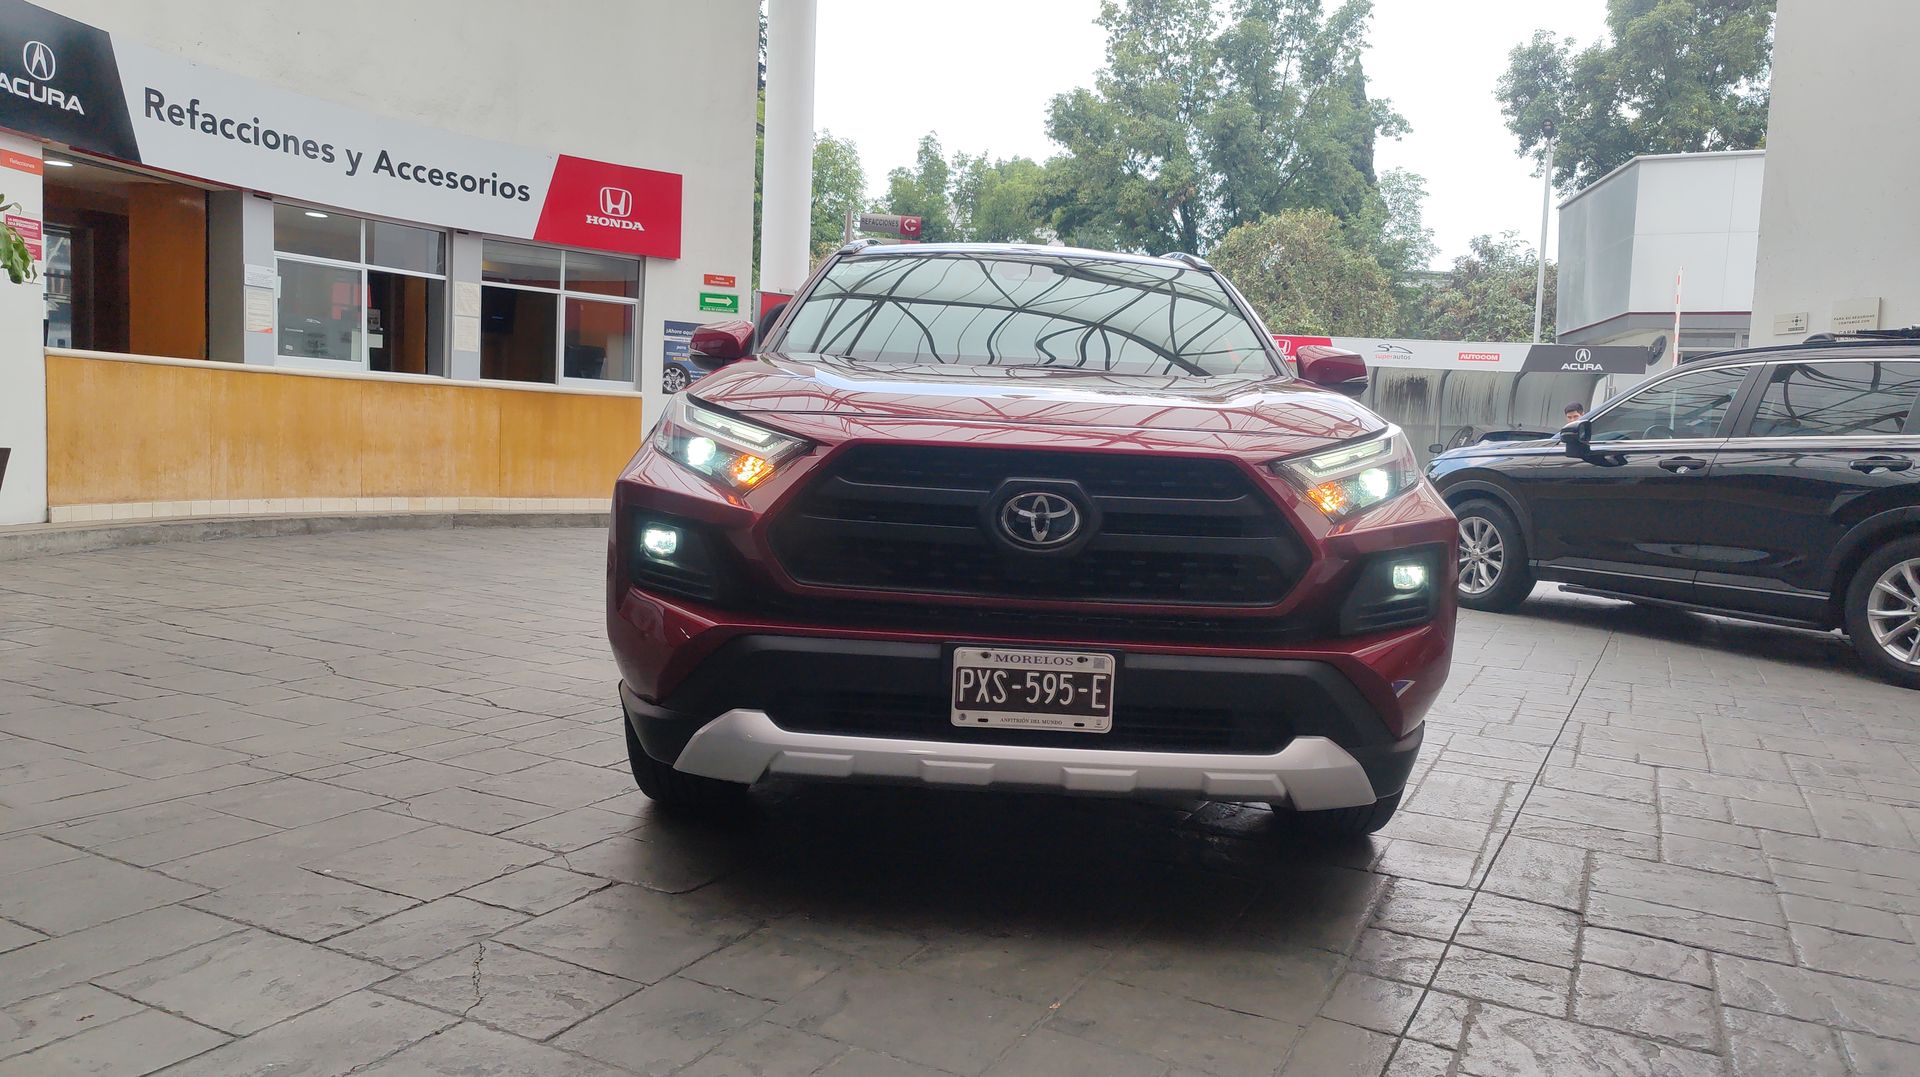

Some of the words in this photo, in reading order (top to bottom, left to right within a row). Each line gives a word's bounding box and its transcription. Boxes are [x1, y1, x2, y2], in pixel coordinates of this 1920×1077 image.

[0, 72, 85, 115] ACURA
[144, 86, 336, 164] Refacciones
[344, 148, 363, 177] y
[372, 149, 531, 202] Accesorios
[585, 214, 646, 232] HONDA
[860, 217, 898, 228] REFACCIONES
[1459, 353, 1499, 361] AUTOCOM
[1561, 363, 1603, 371] ACURA
[994, 654, 1074, 666] MORELOS
[959, 669, 1107, 709] PXS-595-E
